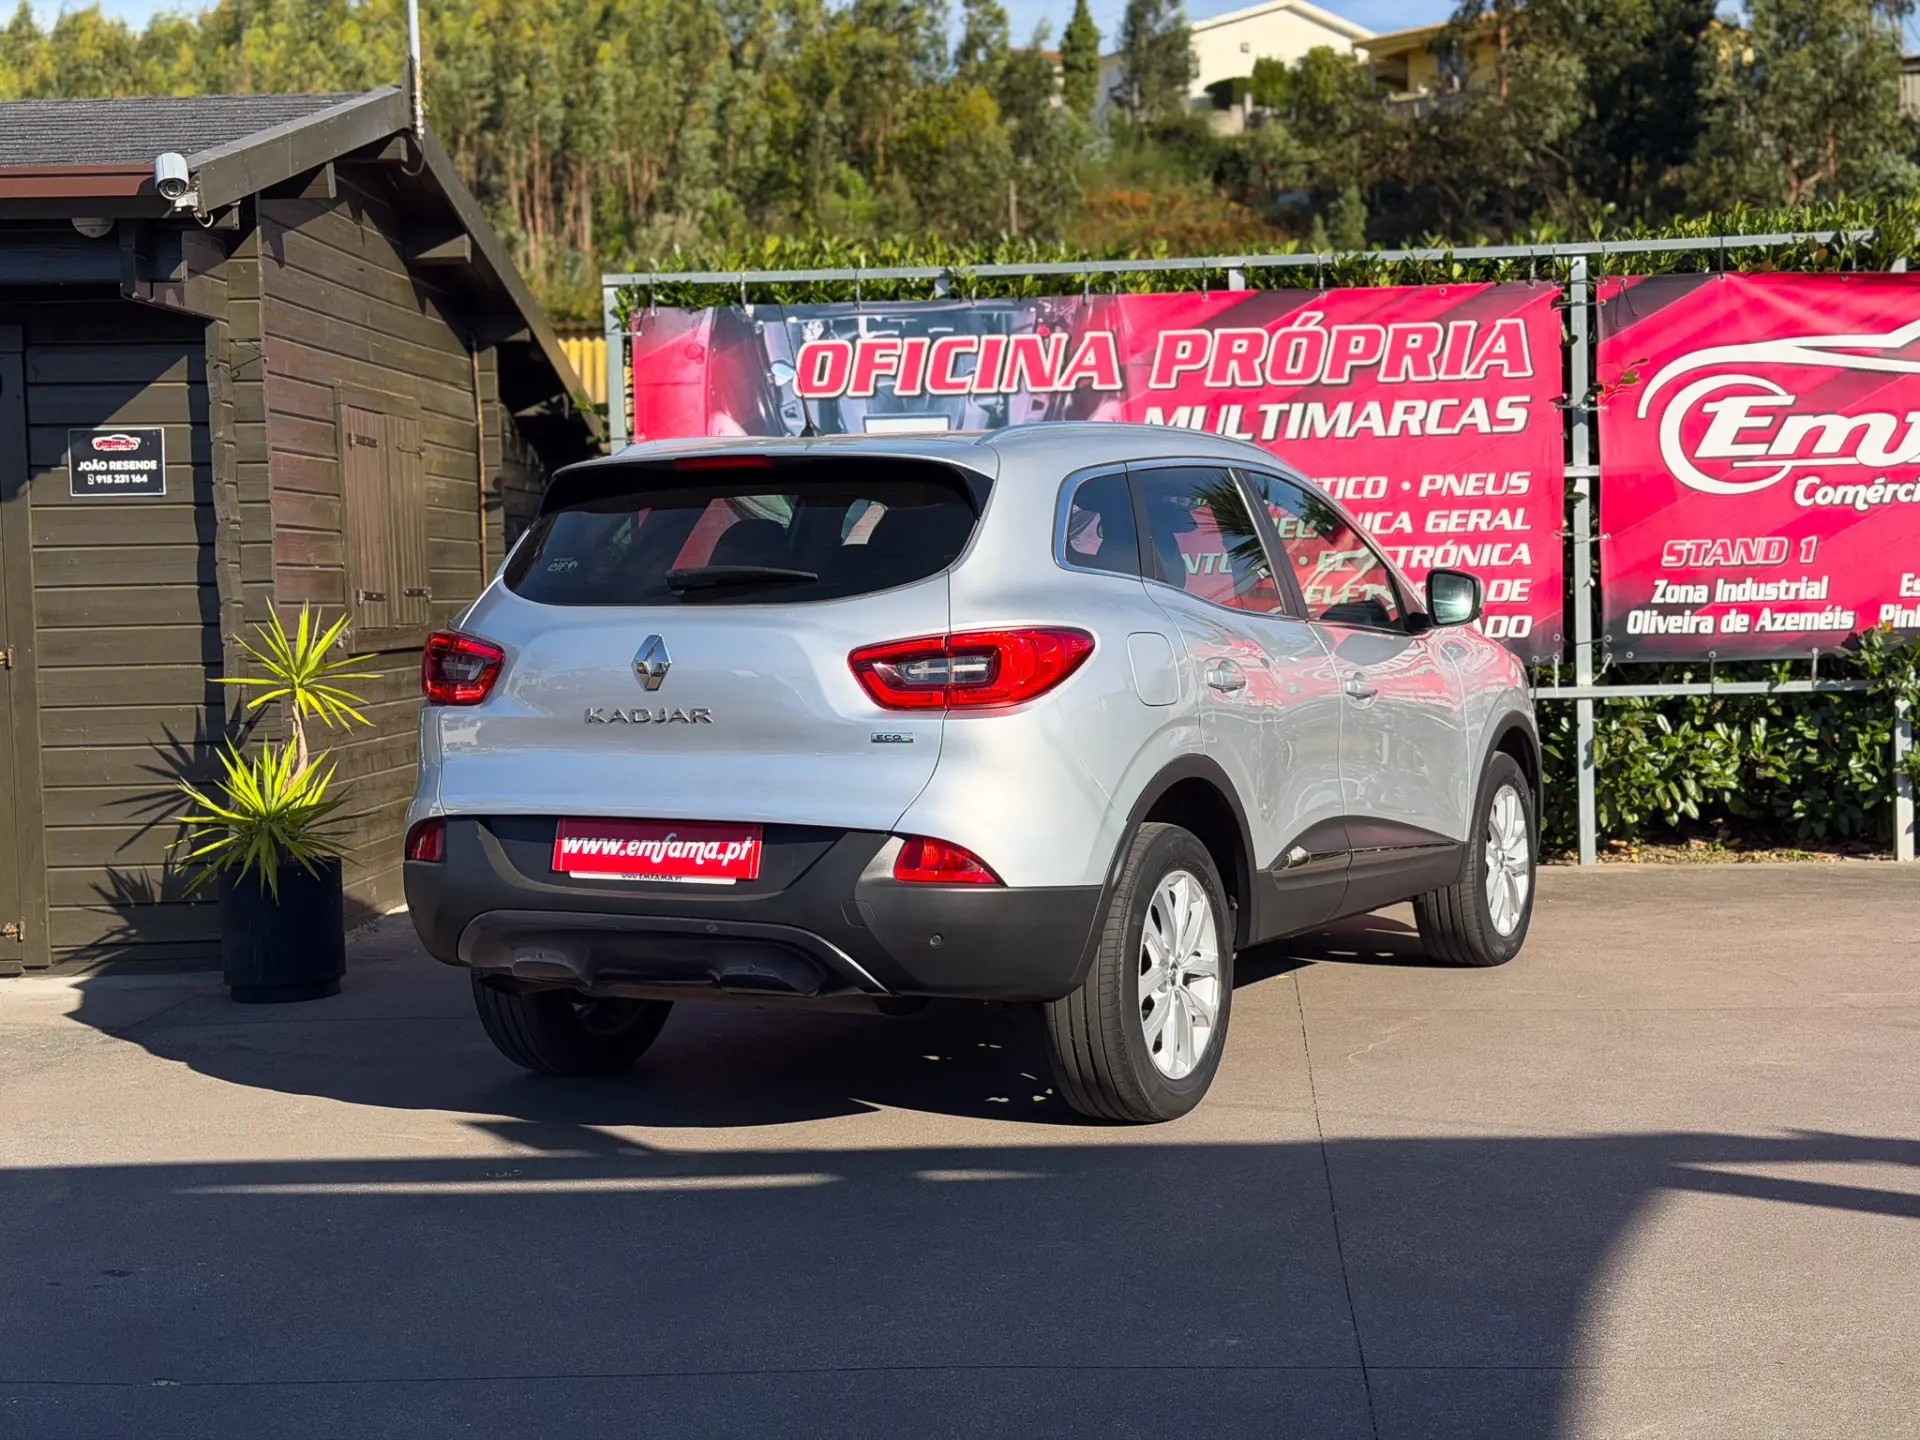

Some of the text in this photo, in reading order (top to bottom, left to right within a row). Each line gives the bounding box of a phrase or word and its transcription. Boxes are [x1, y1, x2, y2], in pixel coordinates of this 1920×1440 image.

[793, 311, 1533, 397] OFICINA PRÓPRIA
[1143, 395, 1531, 440] MULTIMARCAS
[77, 459, 157, 472] JOÃO RESENDE
[95, 473, 149, 484] 915 231 164
[1312, 471, 1531, 500] TICO PNEUS
[1425, 508, 1531, 533] GERAL
[1662, 535, 1819, 568] STAND 1
[1486, 578, 1532, 602] DE
[1650, 576, 1829, 604] Zona Industrial
[1626, 604, 1855, 635] Oliveira de Azeméis
[584, 707, 714, 724] KADJAR
[562, 832, 753, 867] www.emfama.pt
